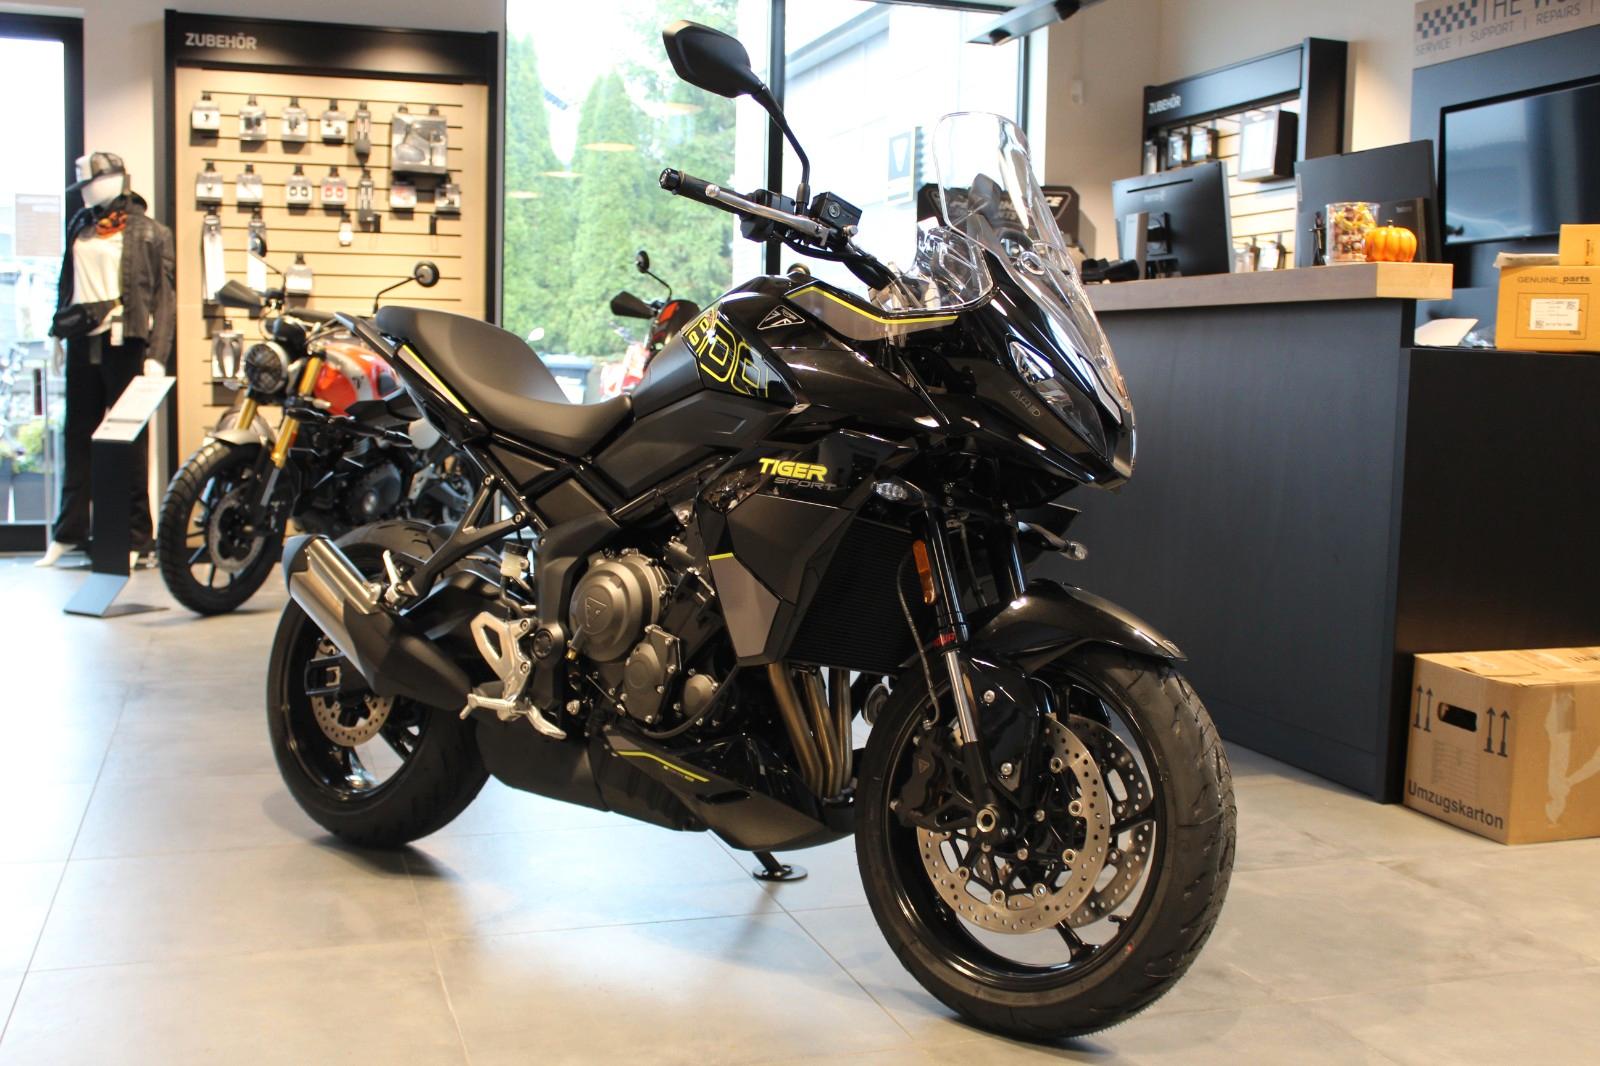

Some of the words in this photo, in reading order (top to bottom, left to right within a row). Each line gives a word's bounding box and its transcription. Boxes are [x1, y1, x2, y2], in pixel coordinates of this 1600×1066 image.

[1416, 37, 1452, 56] SERVICE
[1470, 21, 1513, 43] SUPPORT
[1536, 4, 1581, 26] REPAIRS
[185, 32, 257, 50] ZUBEHÖR
[1517, 275, 1557, 284] GENUINE
[1561, 275, 1590, 285] parts
[759, 457, 828, 482] TIGER
[774, 476, 837, 491] SPORT
[1408, 780, 1504, 829] Umzugskarton
